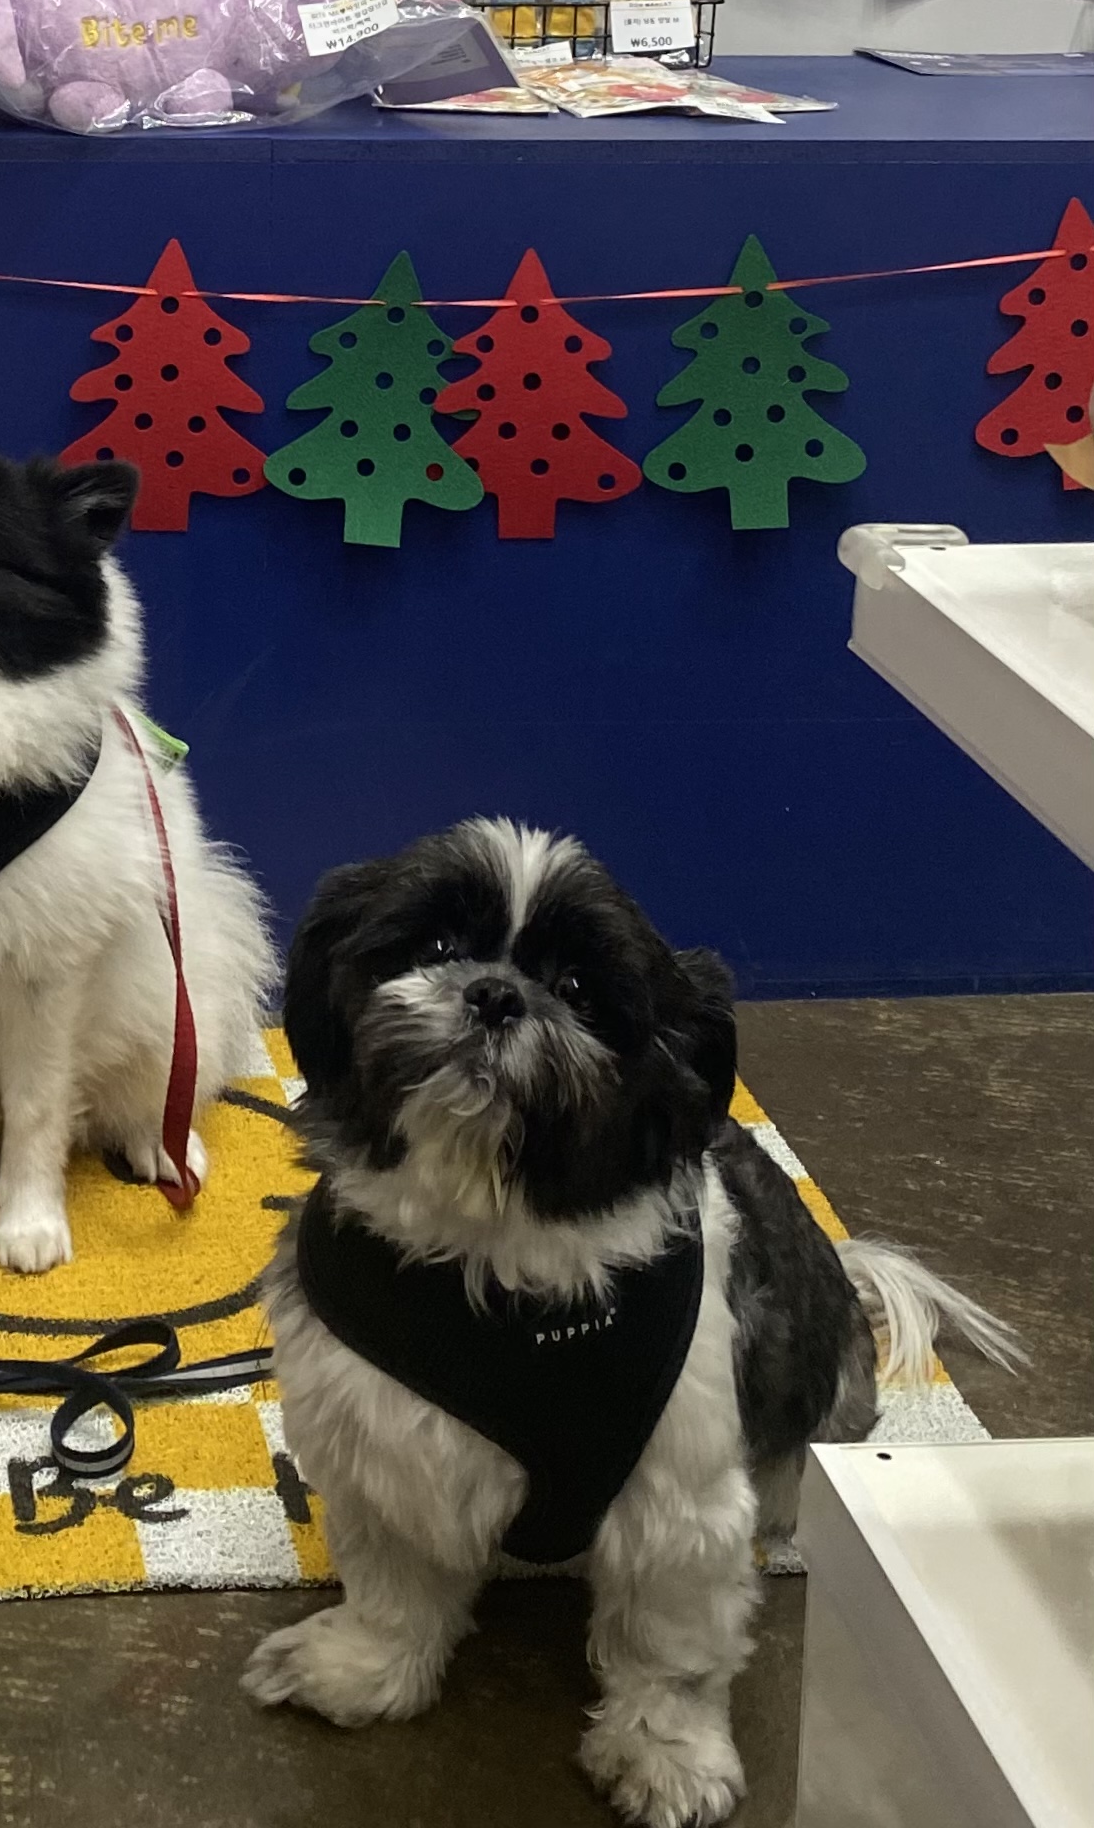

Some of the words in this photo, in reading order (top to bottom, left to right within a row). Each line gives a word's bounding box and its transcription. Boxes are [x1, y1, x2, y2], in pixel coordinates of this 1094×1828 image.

[80, 15, 147, 48] Bite
[154, 14, 199, 44] me
[326, 23, 379, 50] ₩14,900
[630, 36, 673, 48] ₩6,500
[536, 1315, 614, 1345] PUPPIA
[10, 1455, 190, 1534] Be
